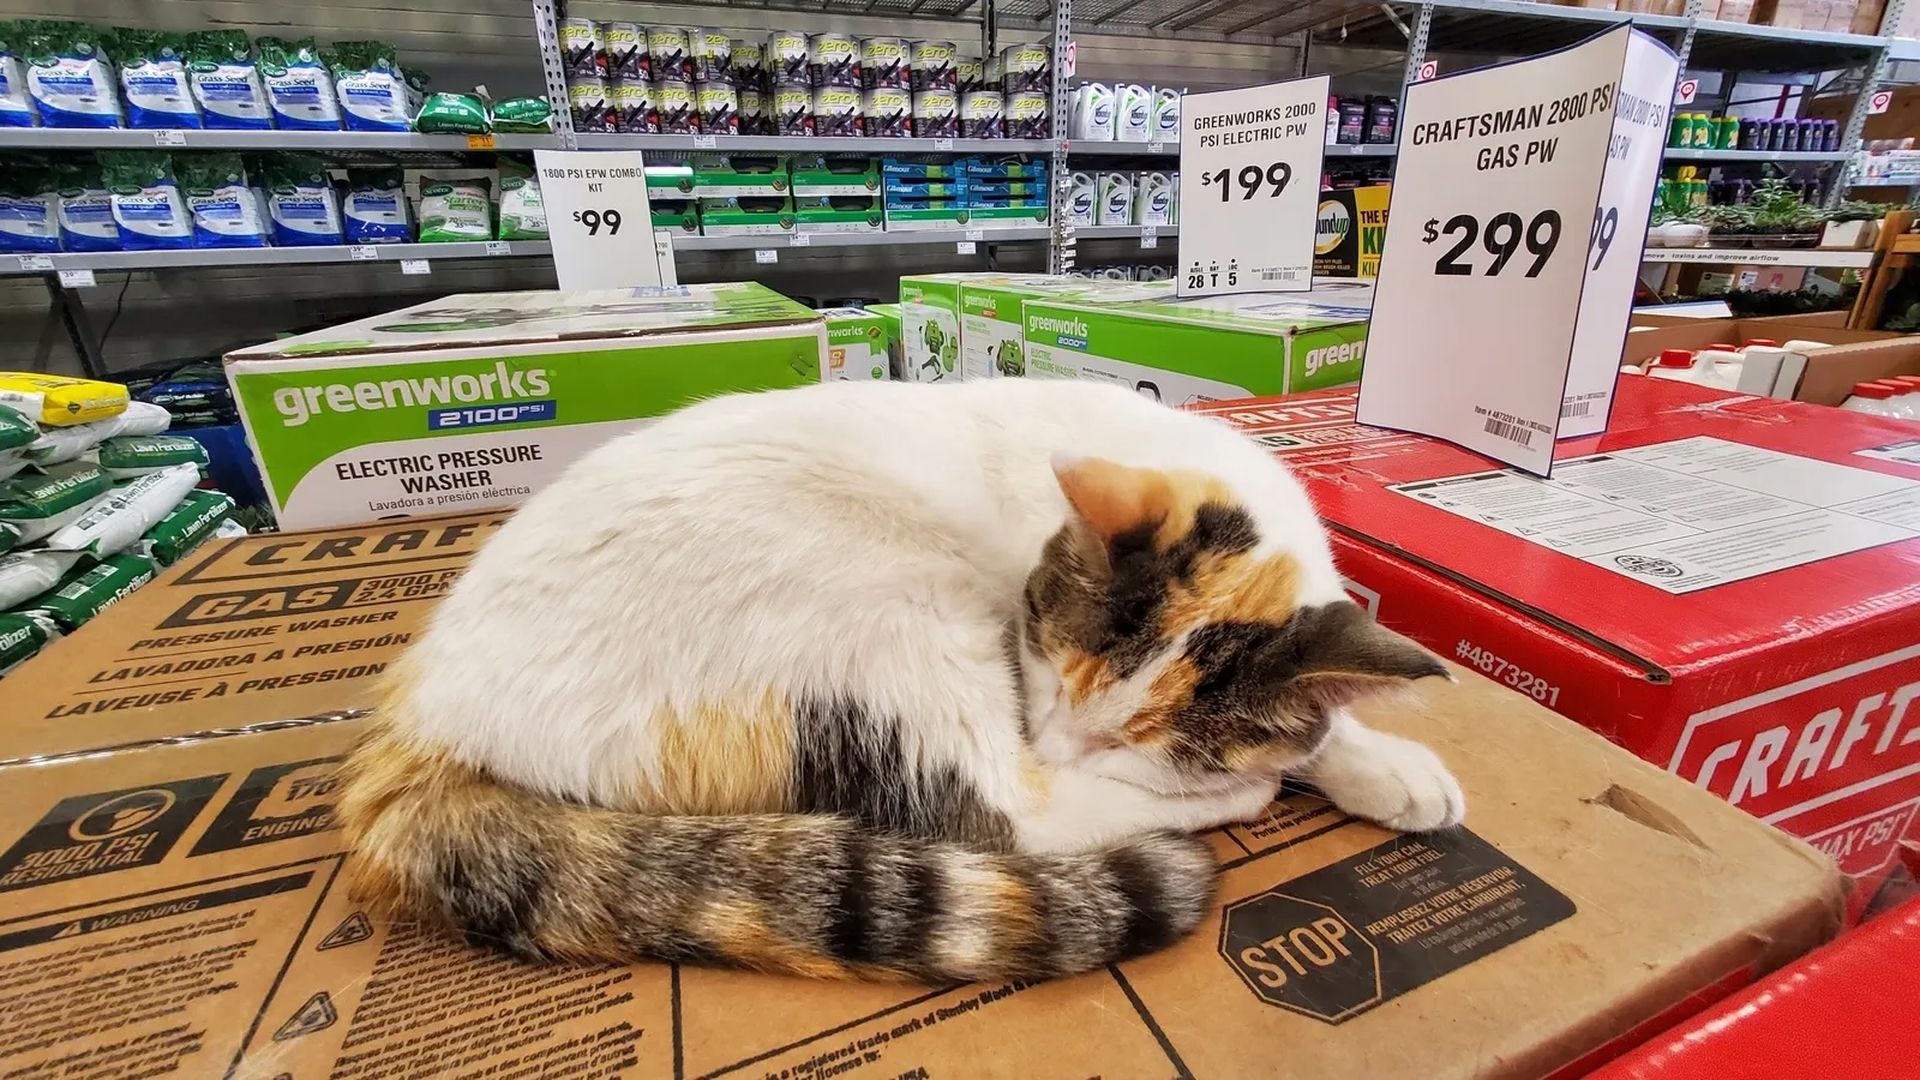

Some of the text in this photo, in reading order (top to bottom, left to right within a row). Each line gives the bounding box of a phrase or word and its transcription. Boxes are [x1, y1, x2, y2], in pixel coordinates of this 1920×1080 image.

[290, 78, 316, 86] Seed
[1194, 102, 1316, 130] GREENWORKS 2000
[1413, 104, 1544, 146] CRAFTSMAN
[1548, 92, 1588, 126] 2800
[1590, 82, 1616, 115] PSI
[1650, 104, 1666, 128] PSI
[1200, 122, 1308, 148] PSI ELECTRIC PW
[1476, 138, 1559, 171] GAS PW
[543, 168, 642, 178] 1800 PSI EPW COMBO
[588, 183, 603, 192] KIT
[1202, 162, 1292, 202] $199
[573, 210, 622, 236] $99
[1316, 212, 1350, 240] undup
[1360, 210, 1380, 224] THE
[1422, 209, 1562, 278] $299
[1750, 254, 1780, 262] airflow
[1188, 272, 1237, 288] 28 T 5
[1029, 314, 1088, 338] greenworks
[274, 362, 550, 426] greenworks
[336, 444, 543, 481] ELECTRIC PRESSURE
[30, 468, 100, 500] Lawn Fertilizer
[118, 470, 164, 504] Lawn Fertilizer
[369, 484, 530, 512] Lavadora a presión eléctrica
[400, 470, 492, 495] WASHER
[182, 501, 228, 538] Lawn Fertilizer
[117, 570, 152, 599] Fertilizer
[354, 588, 396, 602] 2.4
[363, 574, 433, 592] 3000
[196, 583, 344, 622] GAS
[128, 611, 398, 651] PRESSURE WASHER
[88, 632, 412, 684] LAVADORA A PRESIÓN
[1456, 639, 1561, 707] #4873281
[44, 663, 387, 719] LAVEUSE À PRESSION
[0, 849, 145, 886] RESIDENTIAL
[16, 831, 156, 872] 3000 PSI
[1354, 842, 1428, 876] FILL YOUR CAN.
[1358, 870, 1396, 888] TREAT
[1392, 858, 1422, 878] YOUR
[91, 900, 200, 932] WARNING
[1365, 902, 1432, 936] REMPLISSEZ
[1427, 886, 1464, 910] VOTRE
[1386, 918, 1435, 944] TRAITEZ
[1430, 902, 1466, 925] VOTRE
[1462, 880, 1526, 908] CARBURANT.
[1240, 916, 1352, 988] STOP
[150, 959, 206, 978] CANNOT
[535, 973, 584, 993] protection
[364, 1006, 555, 1073] personne peut graves
[441, 1045, 468, 1060] pour
[523, 1038, 580, 1063] composés
[791, 1042, 855, 1077] registered
[858, 1032, 890, 1050] trade
[891, 1018, 923, 1038] mark
[923, 1012, 936, 1026] of
[936, 998, 980, 1021] Stanley
[542, 1049, 588, 1072] pouvant
[815, 1048, 882, 1080] license to:
